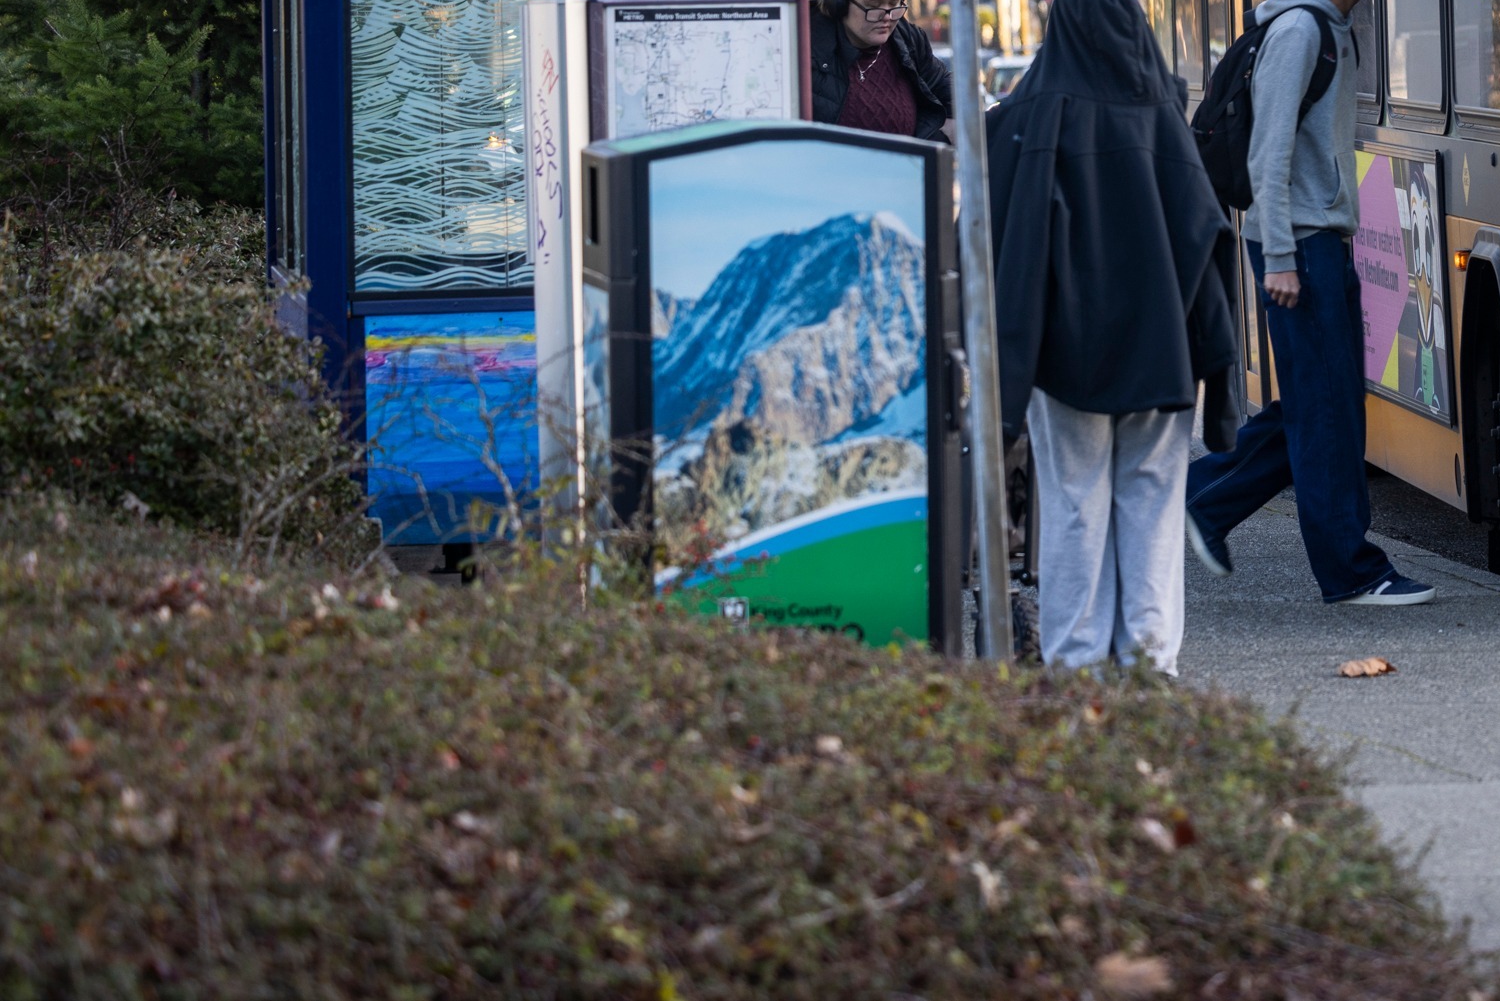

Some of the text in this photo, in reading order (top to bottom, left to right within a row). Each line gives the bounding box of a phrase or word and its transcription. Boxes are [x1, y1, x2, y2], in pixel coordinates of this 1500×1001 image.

[675, 12, 696, 20] Transit
[753, 11, 769, 19] Area
[787, 602, 844, 620] County
